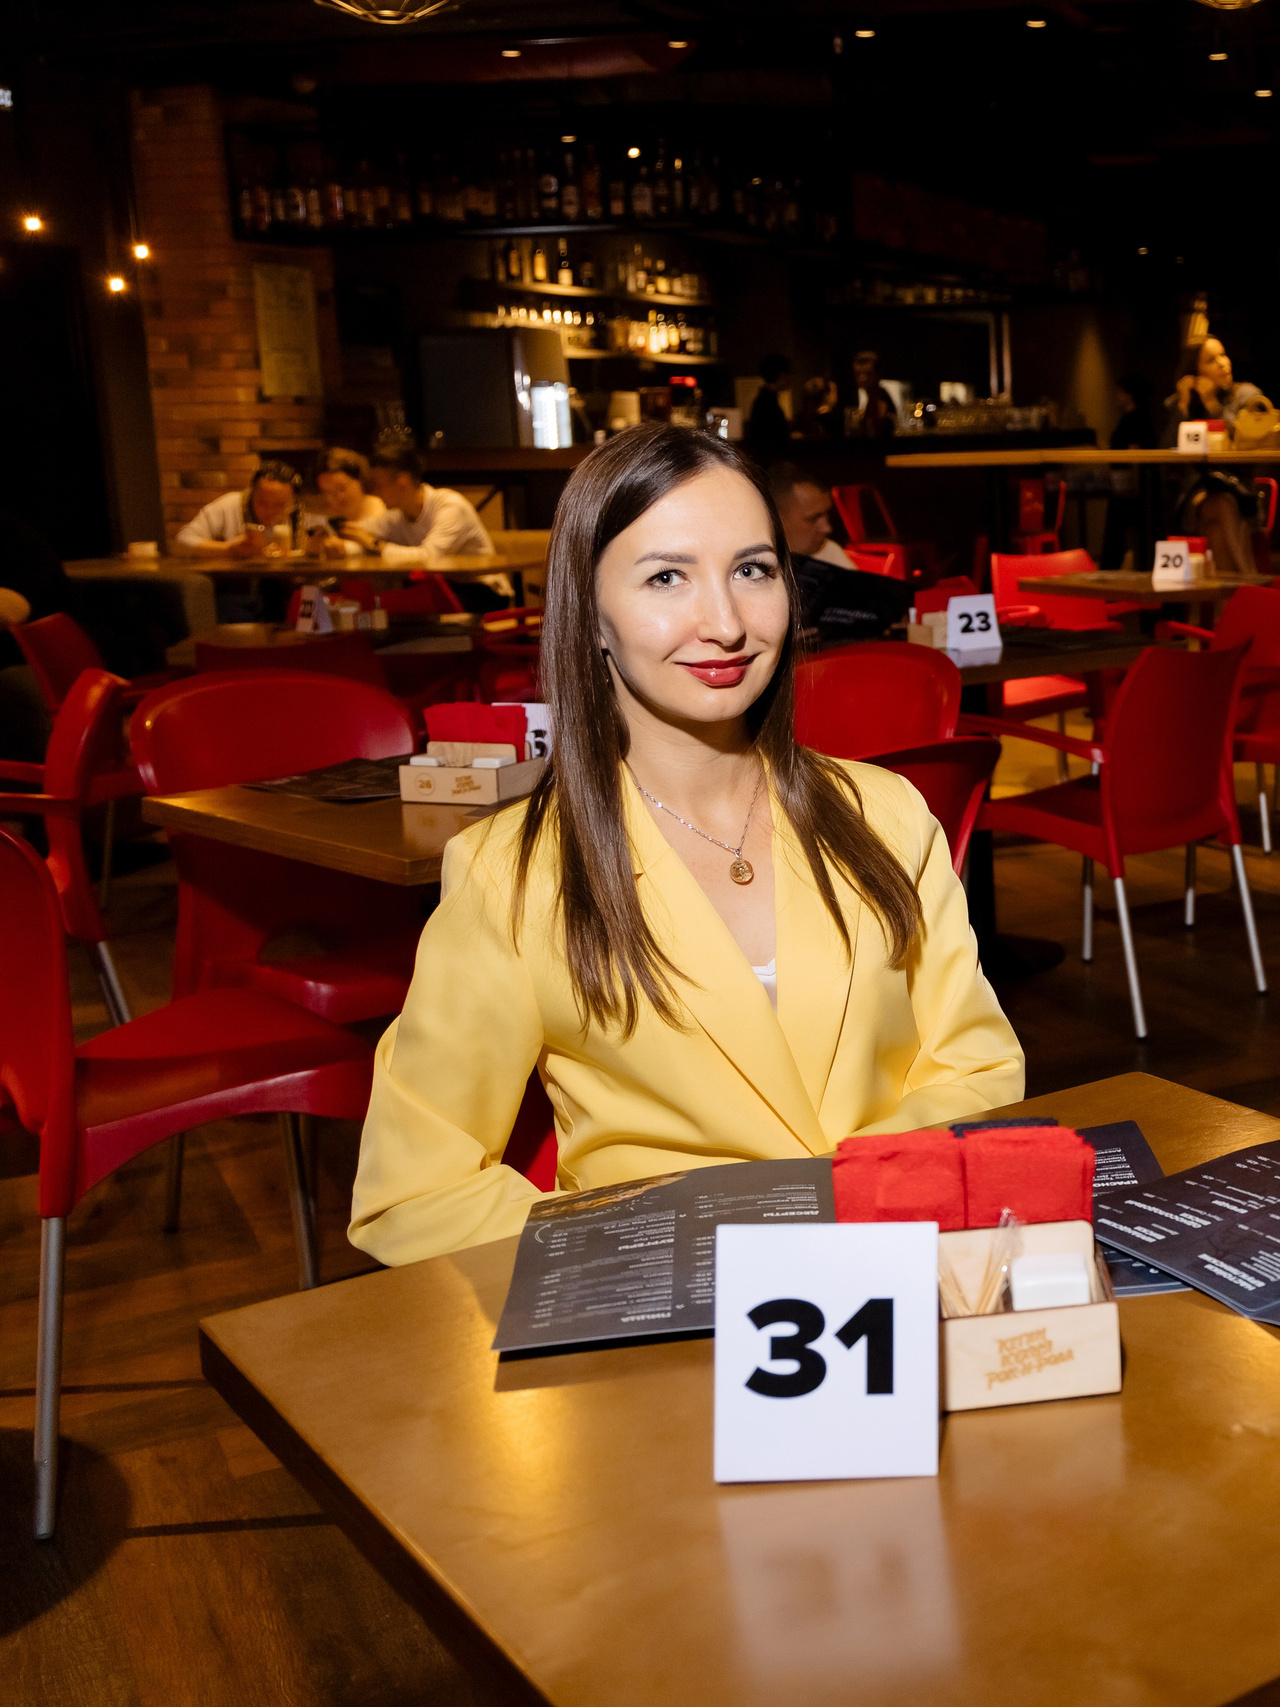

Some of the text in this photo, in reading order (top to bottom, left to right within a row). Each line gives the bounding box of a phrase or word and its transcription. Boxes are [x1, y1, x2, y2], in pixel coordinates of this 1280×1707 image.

[1160, 554, 1184, 568] 20
[958, 610, 992, 634] 23
[1092, 1179, 1138, 1188] КРАСНО
[617, 1238, 674, 1250] БУРГЕРЫ
[744, 1297, 895, 1397] 31
